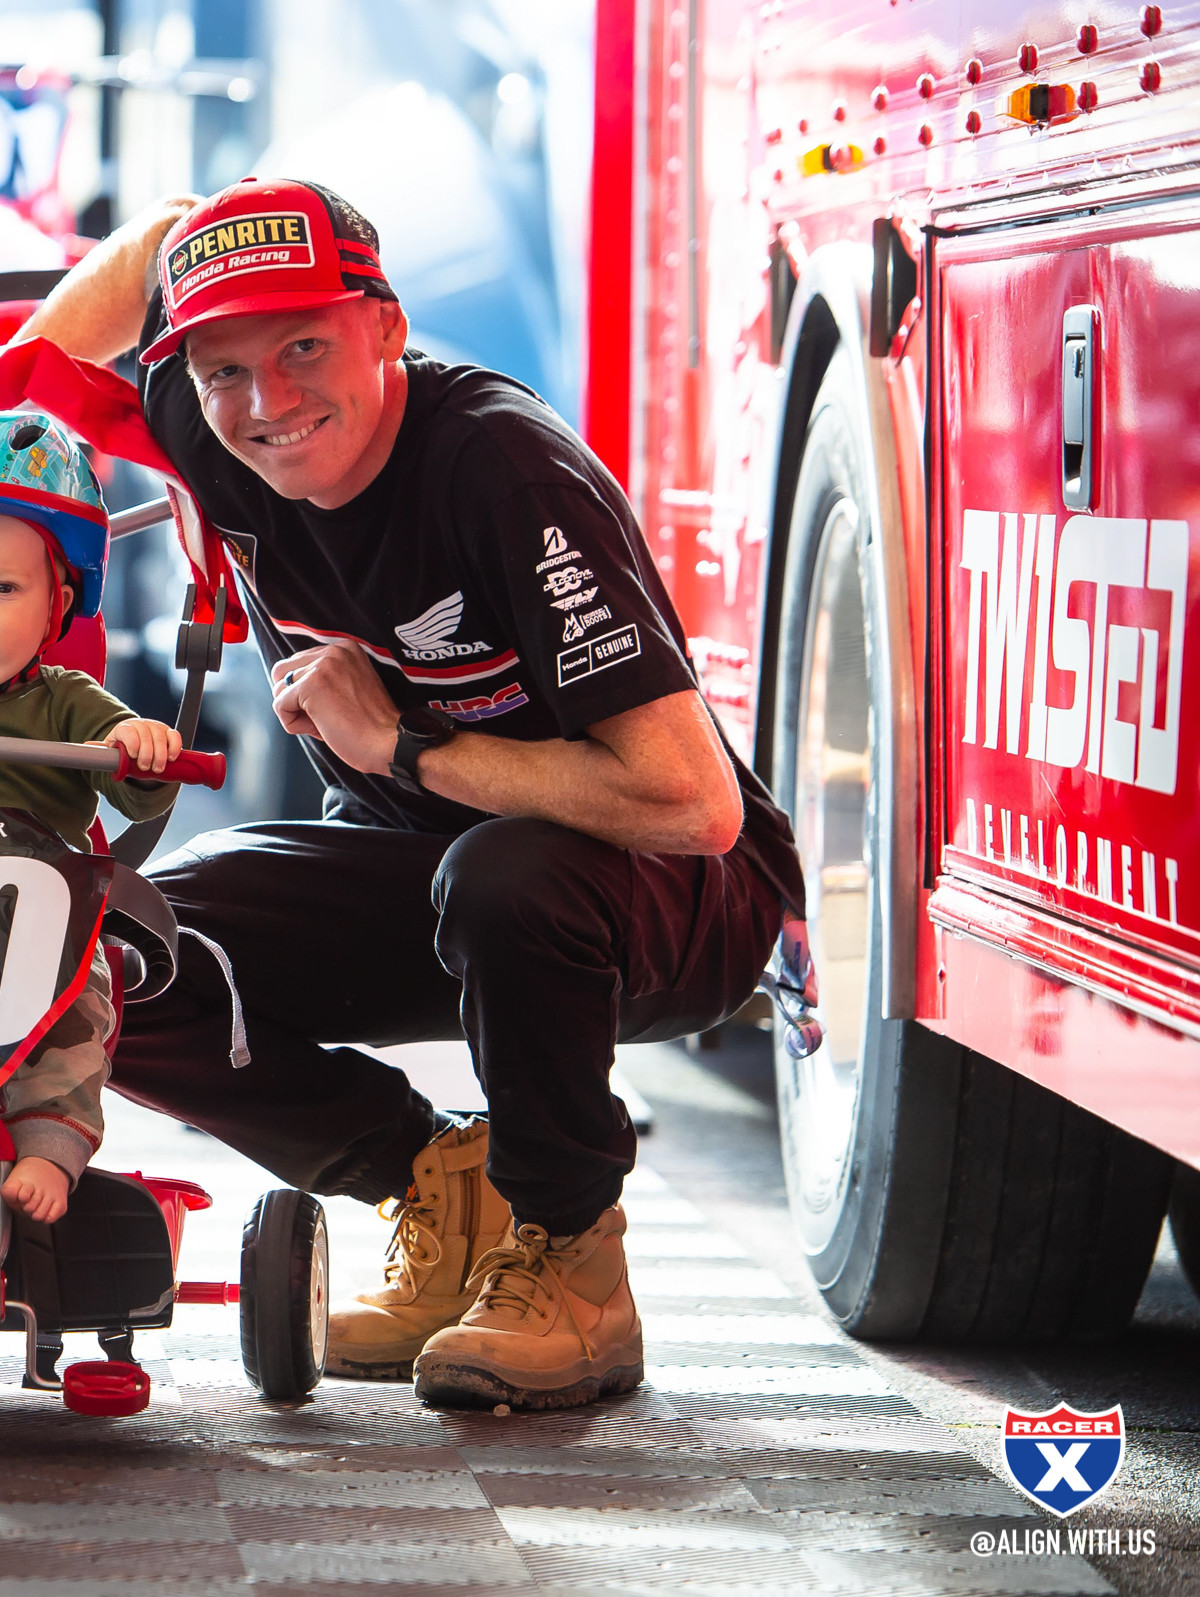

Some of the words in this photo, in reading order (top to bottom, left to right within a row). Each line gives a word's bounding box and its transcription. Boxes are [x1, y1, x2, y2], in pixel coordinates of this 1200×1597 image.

[189, 218, 301, 266] PENRITE
[181, 261, 225, 293] Honda
[227, 250, 291, 269] Racing
[535, 550, 582, 574] BRIDGESTON
[401, 640, 494, 661] HONDA
[561, 656, 588, 671] Honda
[594, 633, 634, 660] GENUINE
[958, 508, 1189, 796] TWISTED
[966, 798, 1179, 927] DEVELOPMENT
